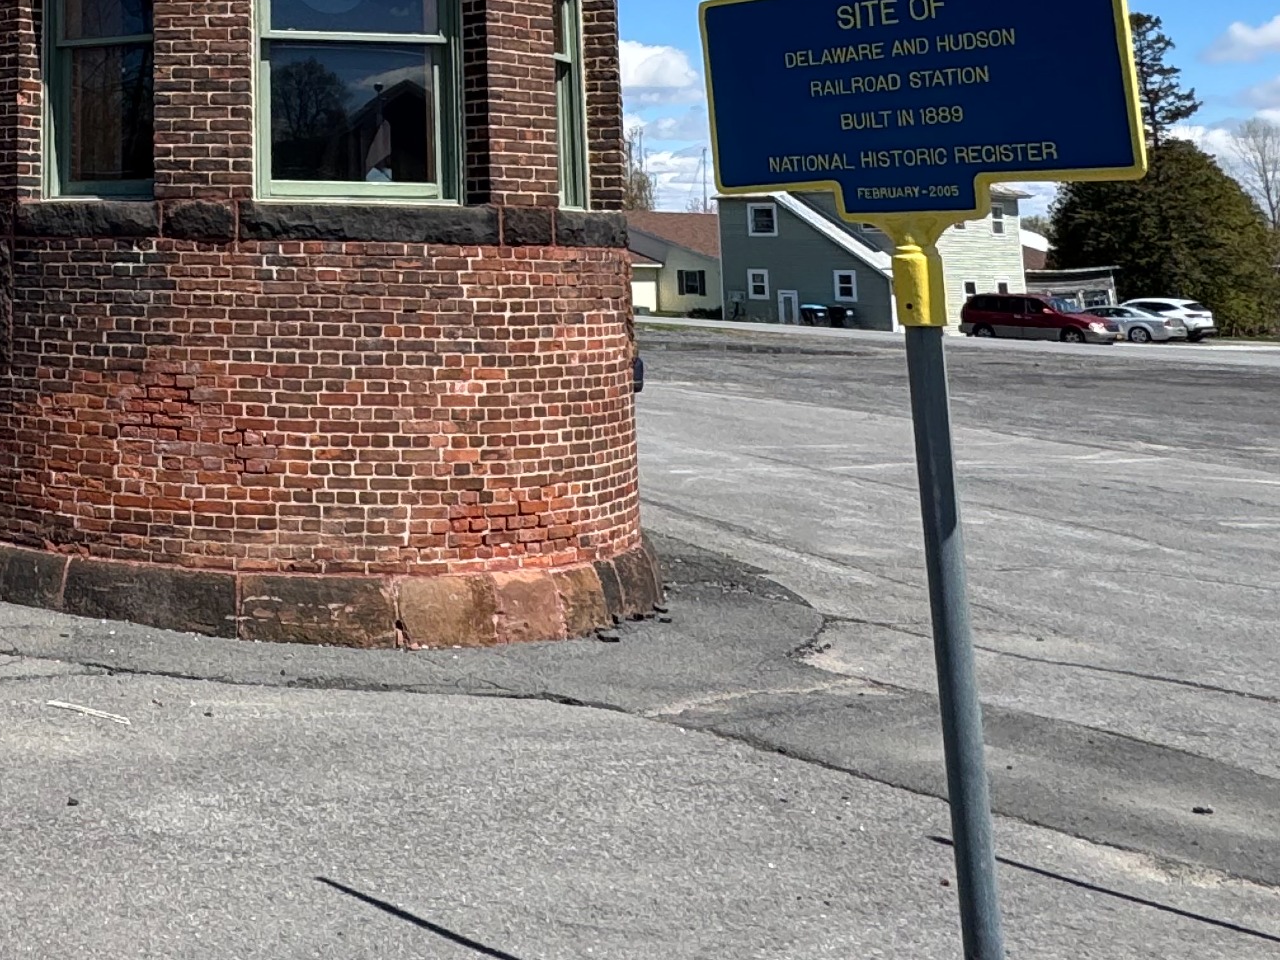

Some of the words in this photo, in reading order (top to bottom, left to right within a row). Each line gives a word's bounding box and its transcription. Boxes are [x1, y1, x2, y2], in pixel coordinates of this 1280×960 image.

[837, 0, 899, 29] SITE
[785, 43, 884, 68] DELAWARE
[892, 38, 928, 56] AND
[937, 29, 1014, 51] HUDSON
[811, 74, 900, 96] RAILROAD
[910, 66, 989, 88] STATION
[841, 111, 891, 129] BUILT
[897, 110, 914, 126] IN
[920, 106, 963, 124] 1889
[769, 153, 854, 172] NATIONAL
[861, 148, 946, 167] HISTORIC
[955, 142, 1057, 163] REGISTER
